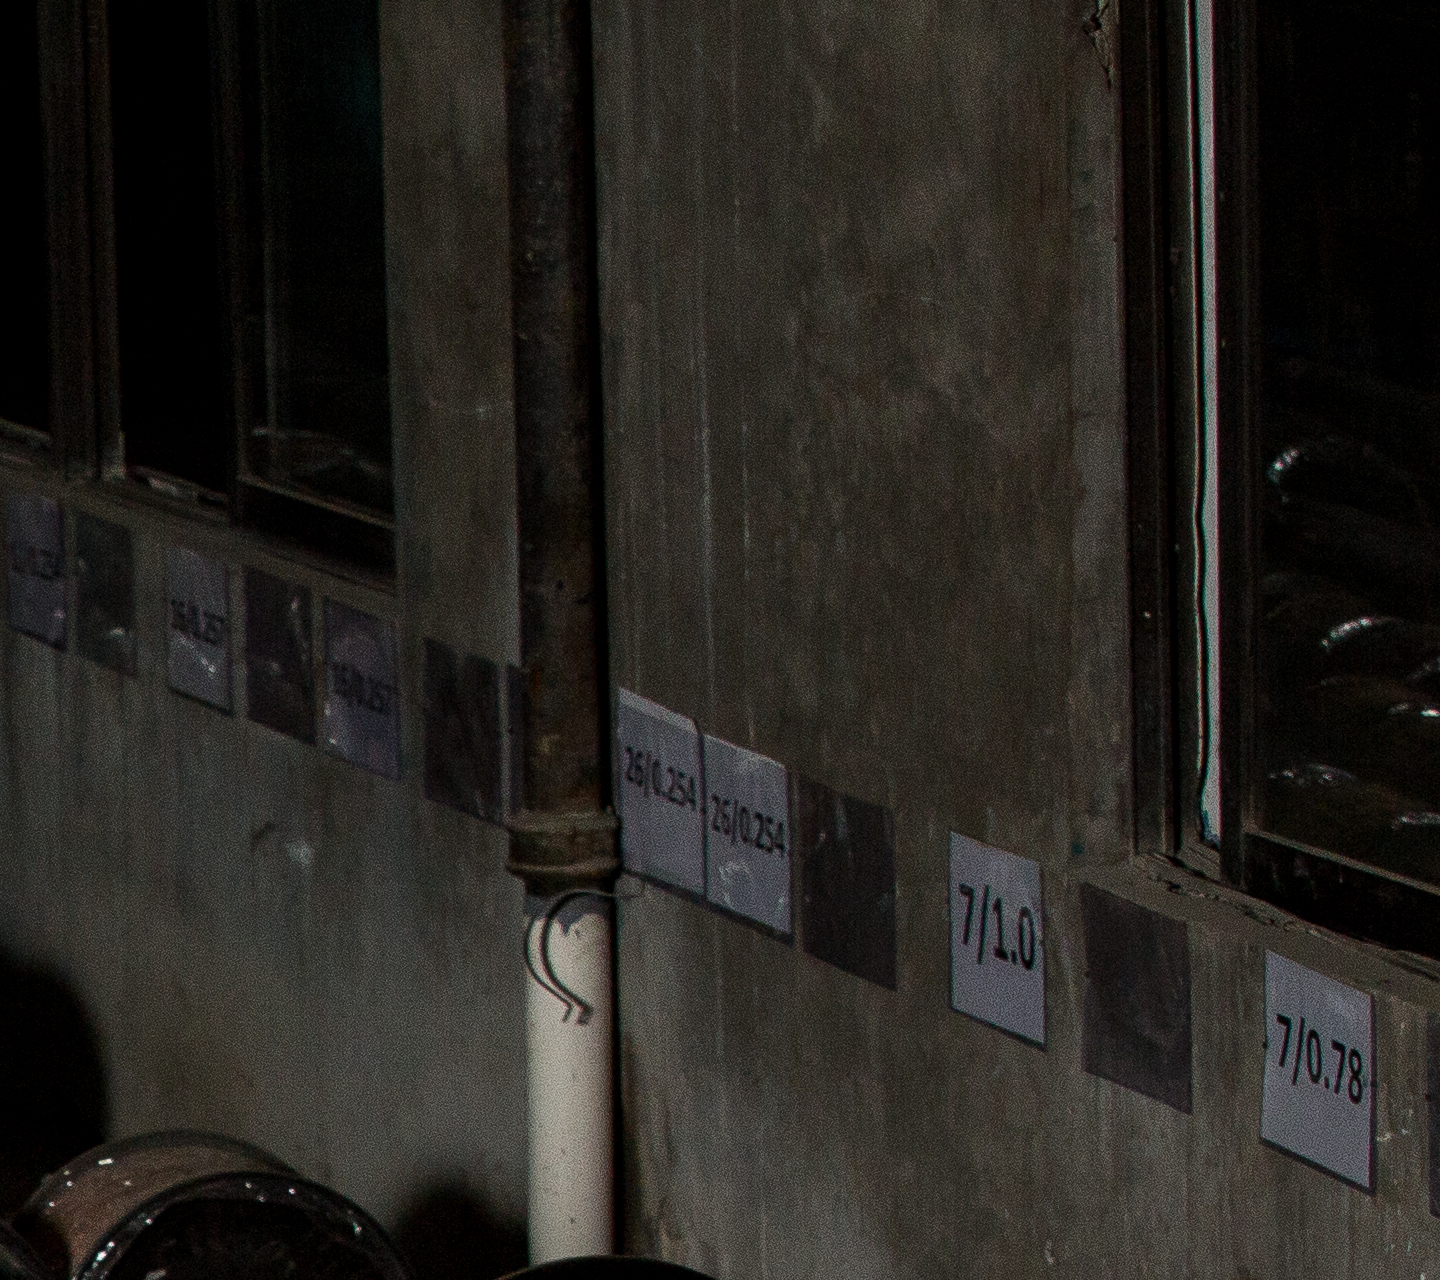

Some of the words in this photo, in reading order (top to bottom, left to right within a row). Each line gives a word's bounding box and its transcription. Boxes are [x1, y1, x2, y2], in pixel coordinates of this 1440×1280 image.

[626, 746, 696, 812] 26/0.254
[711, 794, 785, 858] 26/0.254
[959, 883, 1034, 970] 7/1.0
[1277, 1013, 1362, 1104] 7/0.78
